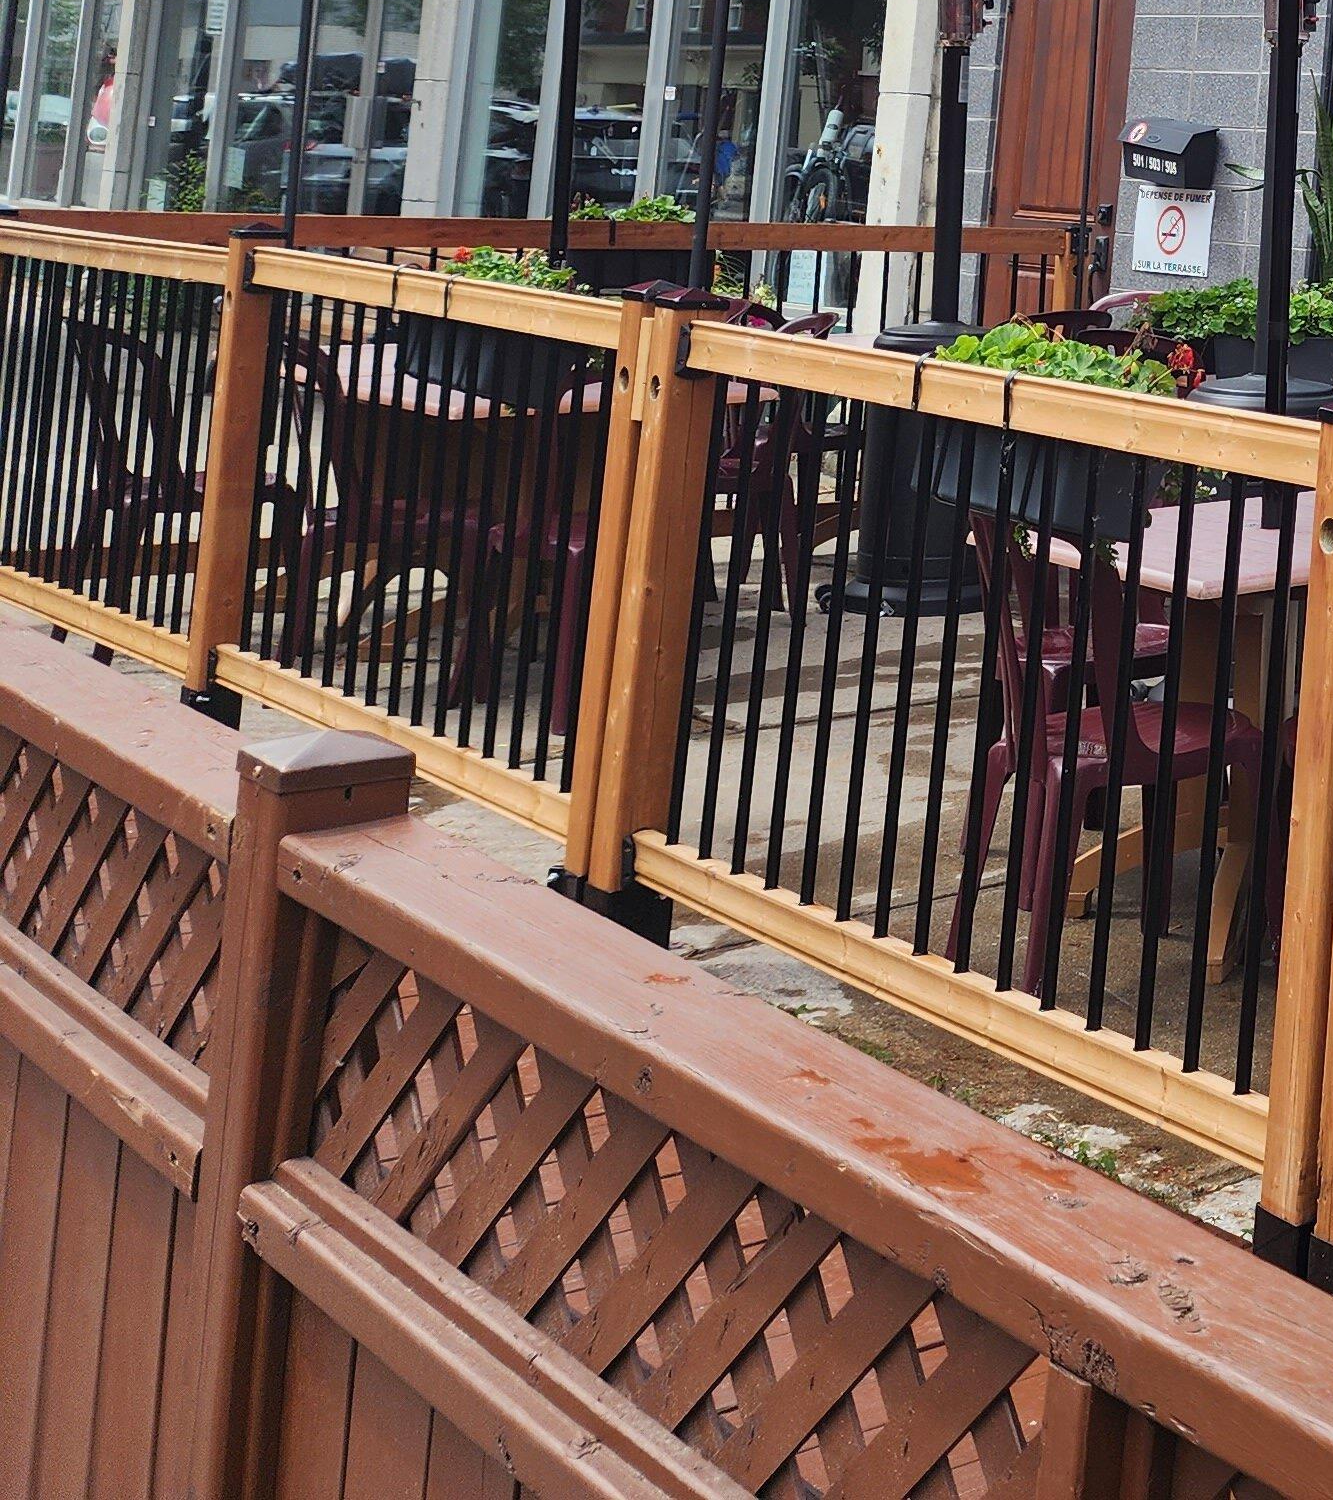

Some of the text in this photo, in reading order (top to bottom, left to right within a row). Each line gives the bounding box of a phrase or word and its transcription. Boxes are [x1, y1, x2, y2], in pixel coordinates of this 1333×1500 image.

[1173, 193, 1184, 202] DE
[1184, 194, 1211, 204] FUMER
[1137, 259, 1202, 274] SUR LA TERRASSE
